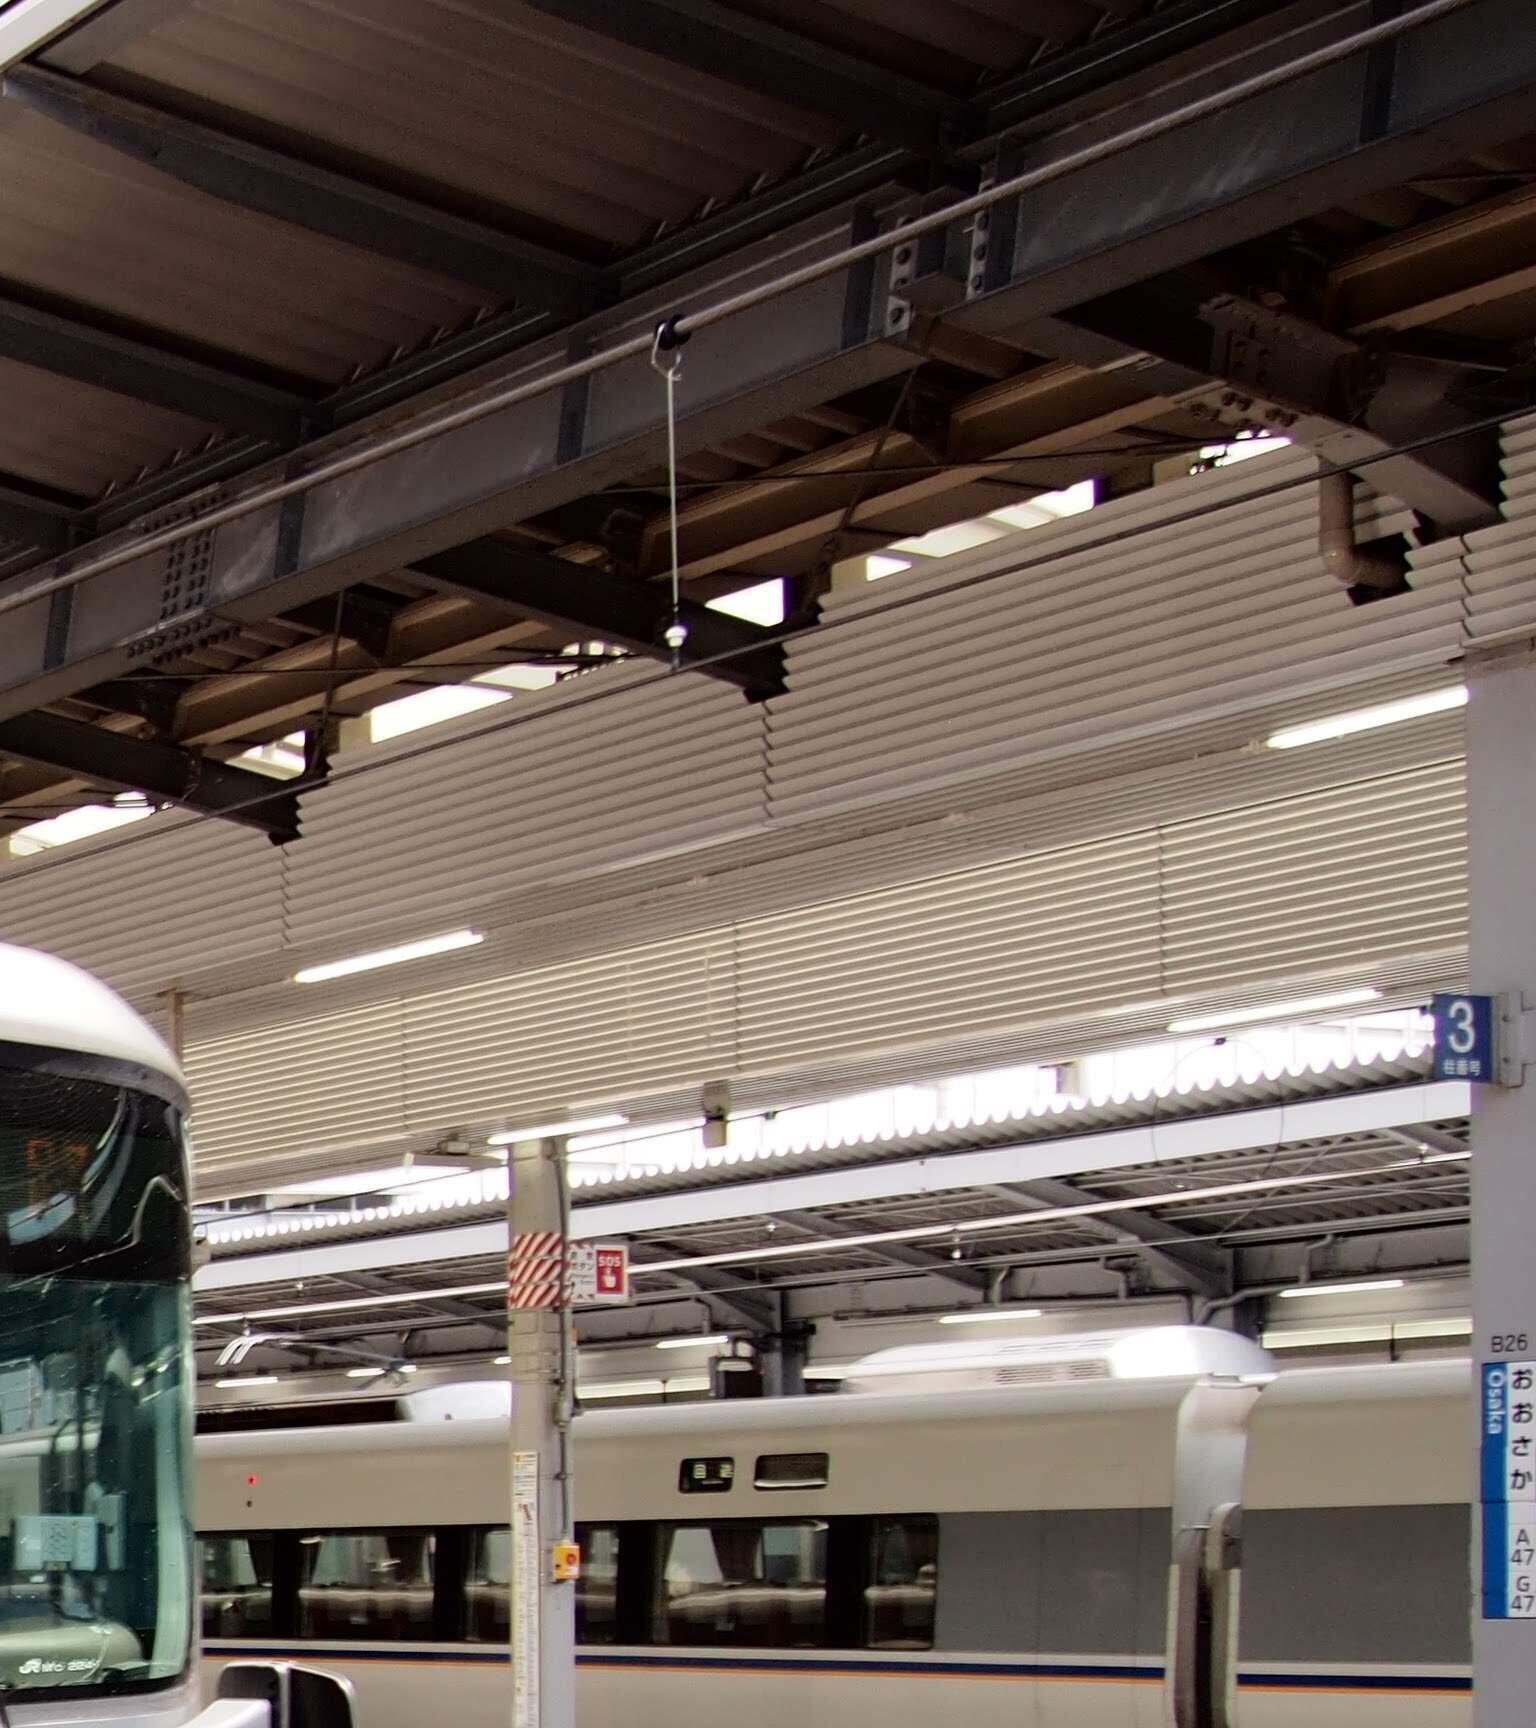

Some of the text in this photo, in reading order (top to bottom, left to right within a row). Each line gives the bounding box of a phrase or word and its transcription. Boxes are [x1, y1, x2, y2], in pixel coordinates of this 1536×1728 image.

[1448, 999, 1476, 1054] 3
[599, 1256, 622, 1267] SOS
[1490, 1334, 1528, 1353] B26
[1486, 1369, 1506, 1435] Osaka
[1510, 1369, 1534, 1491] おおさか
[1516, 1529, 1530, 1546] A
[1510, 1549, 1535, 1566] 47
[1515, 1575, 1530, 1592] G
[1510, 1595, 1535, 1613] 47
